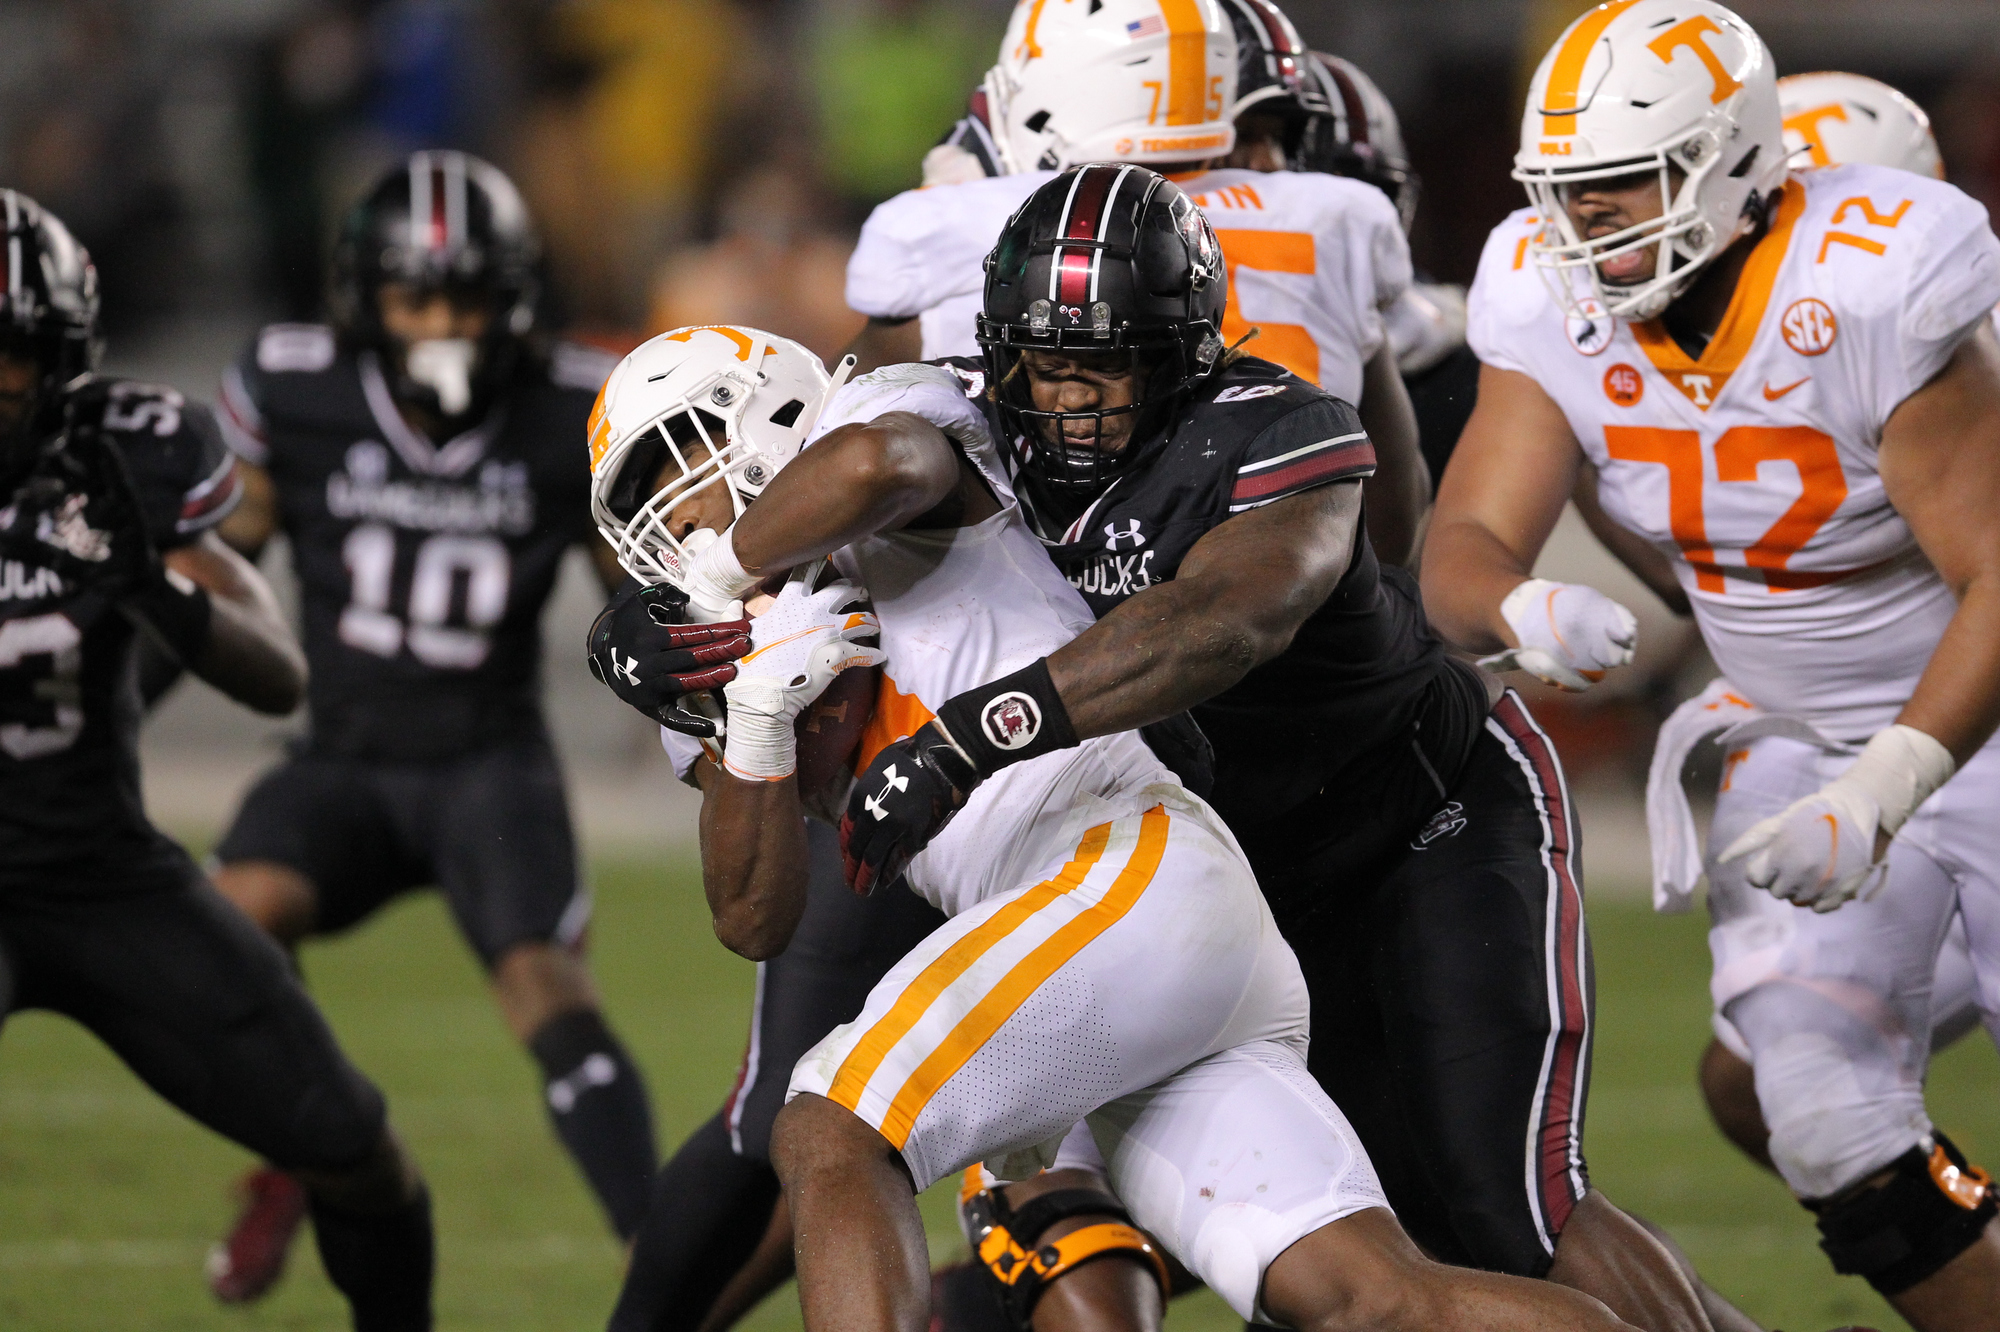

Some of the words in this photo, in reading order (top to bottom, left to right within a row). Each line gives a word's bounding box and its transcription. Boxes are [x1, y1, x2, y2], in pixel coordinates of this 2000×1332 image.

[1646, 15, 1743, 105] T
[1815, 195, 1913, 264] 72
[1783, 300, 1833, 351] SEC
[1681, 374, 1713, 405] T
[1602, 424, 1882, 595] 72
[338, 522, 511, 670] 10
